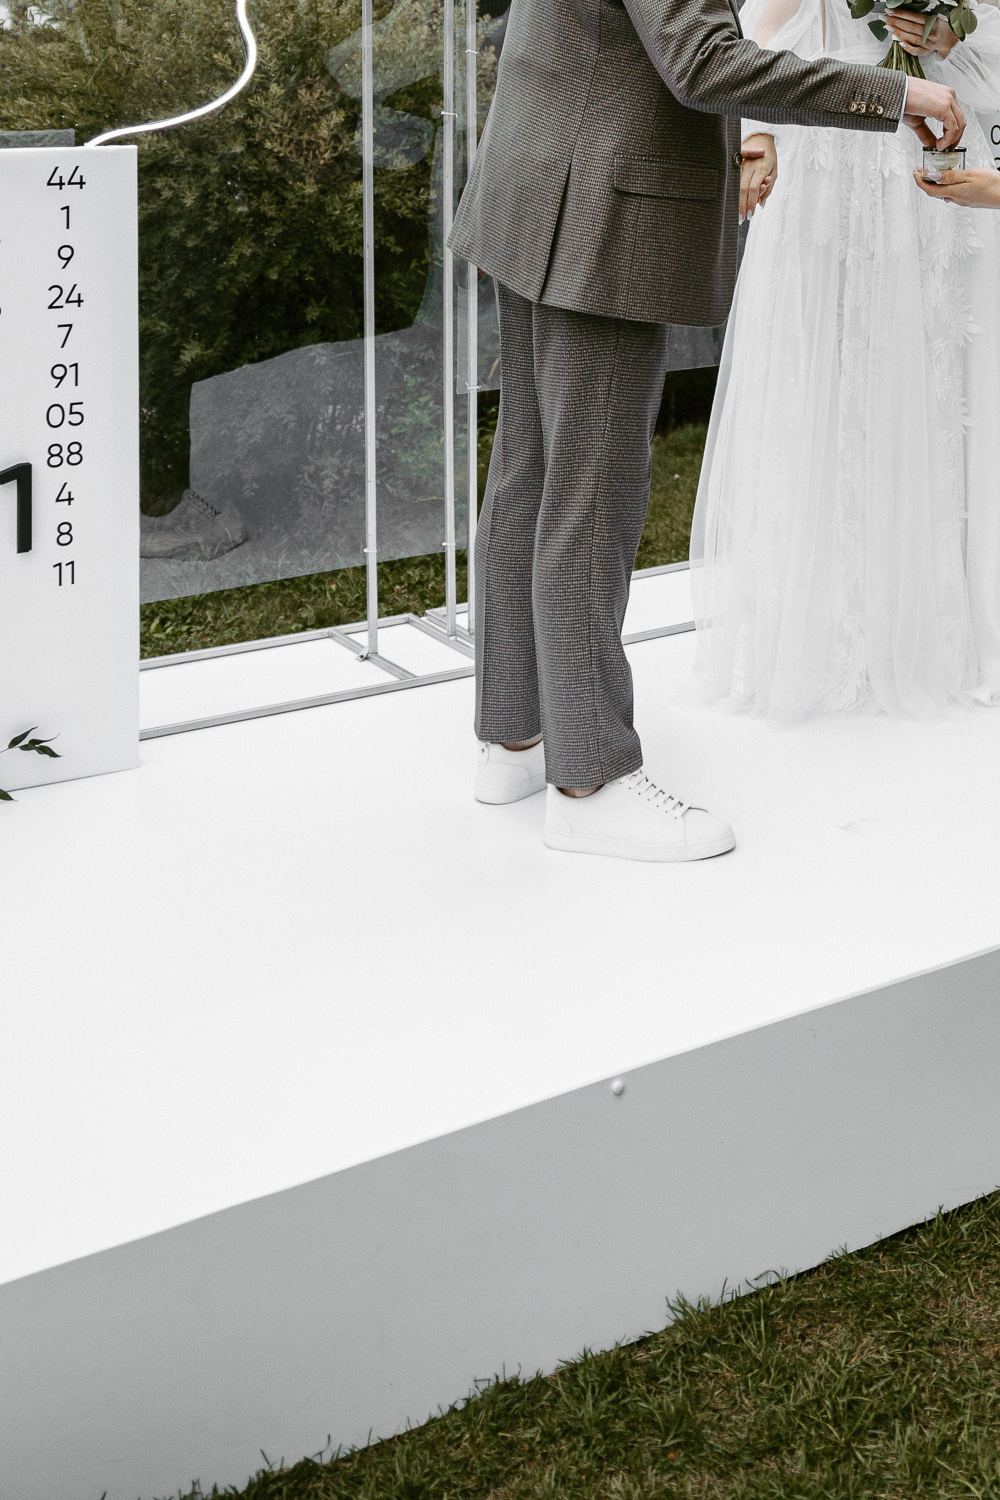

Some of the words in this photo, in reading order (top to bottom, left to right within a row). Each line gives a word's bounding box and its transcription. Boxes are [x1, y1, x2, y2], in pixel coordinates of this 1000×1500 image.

[46, 166, 86, 190] 44
[60, 206, 70, 229] 1
[57, 245, 74, 269] 9
[47, 284, 84, 309] 24
[57, 324, 73, 348] 7
[51, 363, 79, 388] 91
[46, 402, 85, 428] 05
[46, 442, 84, 468] 88
[55, 482, 75, 505] 4
[56, 522, 73, 546] 8
[53, 561, 75, 586] 11
